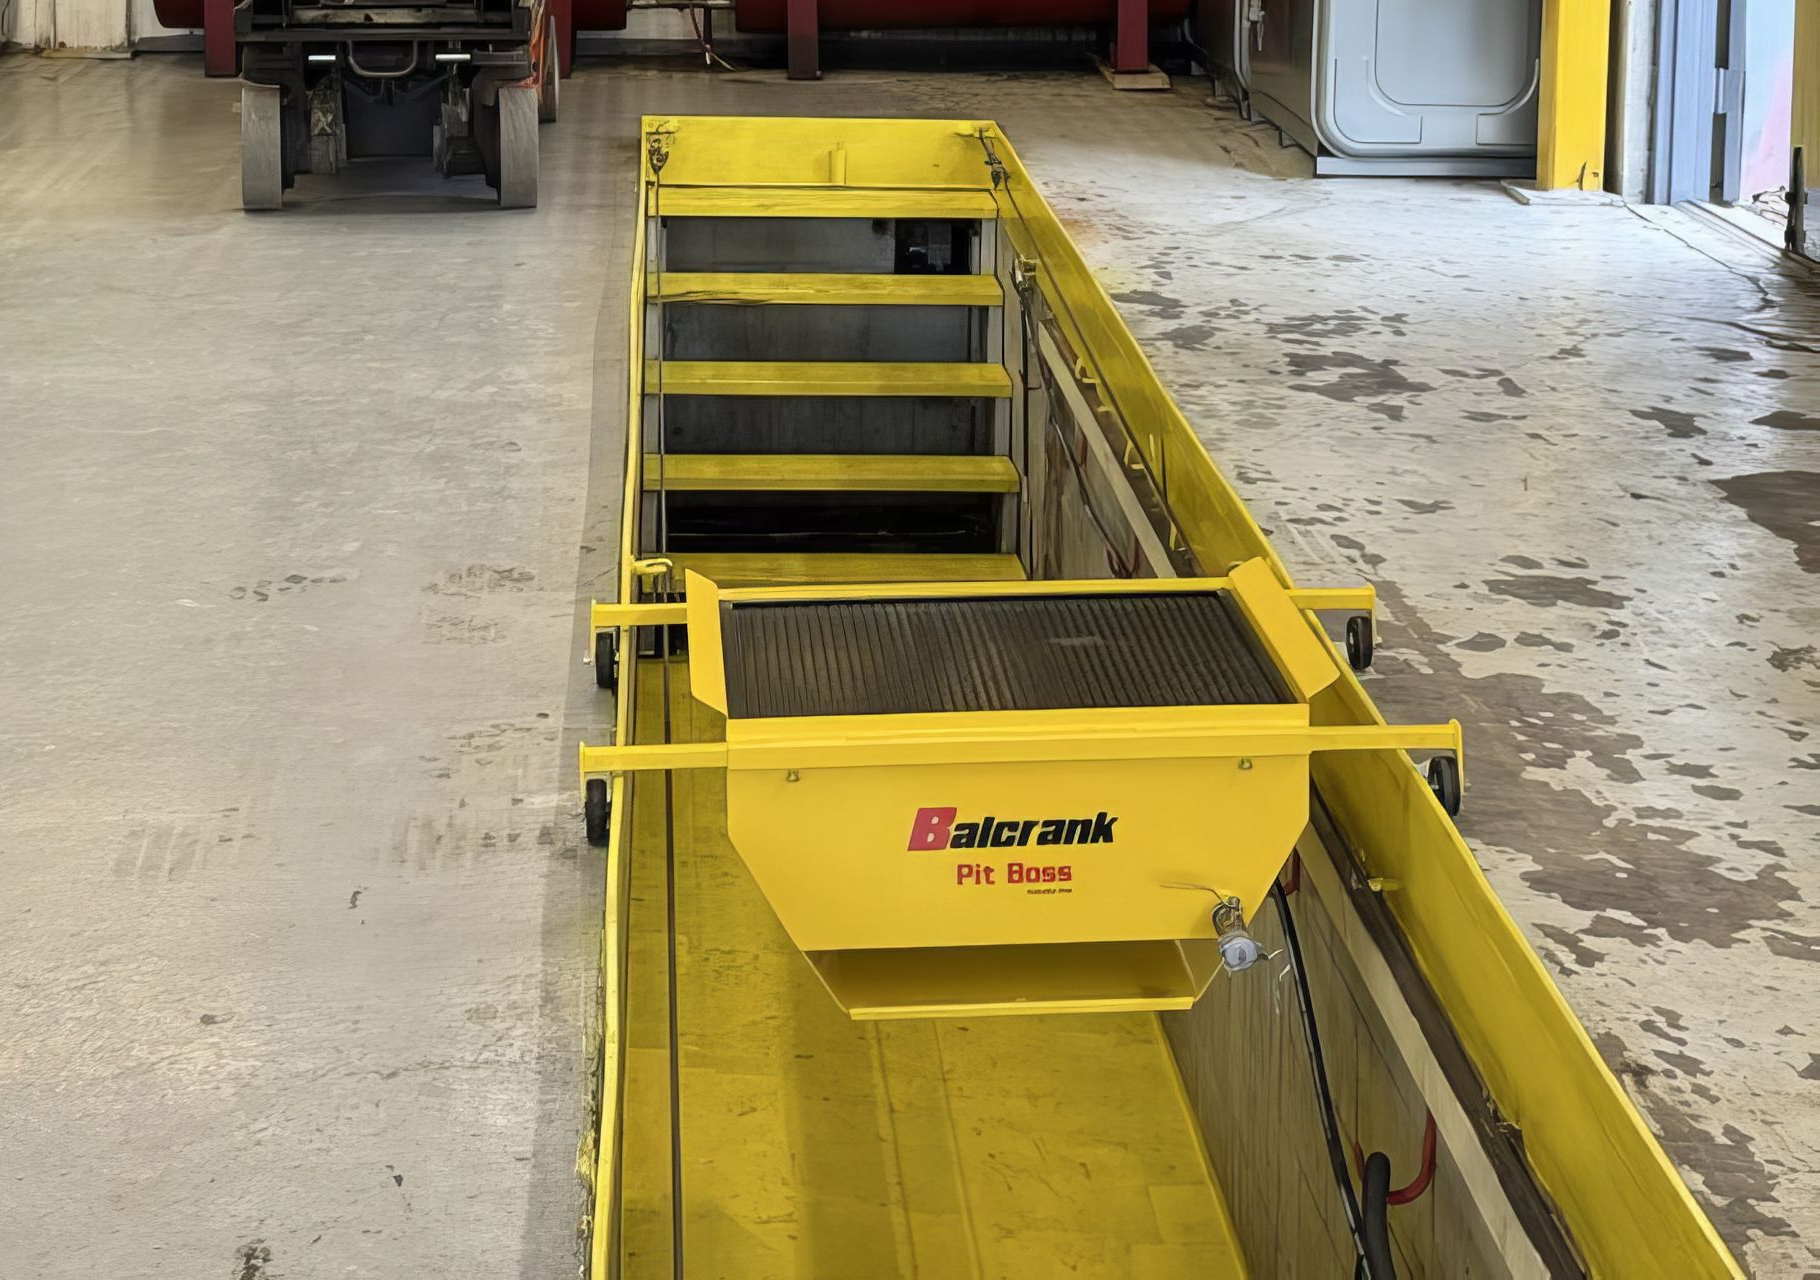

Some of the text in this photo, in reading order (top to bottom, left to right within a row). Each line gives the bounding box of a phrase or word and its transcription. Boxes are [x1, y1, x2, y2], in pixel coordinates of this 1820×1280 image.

[907, 807, 1118, 851] Balcrank
[957, 862, 1072, 885] Pit Boss
